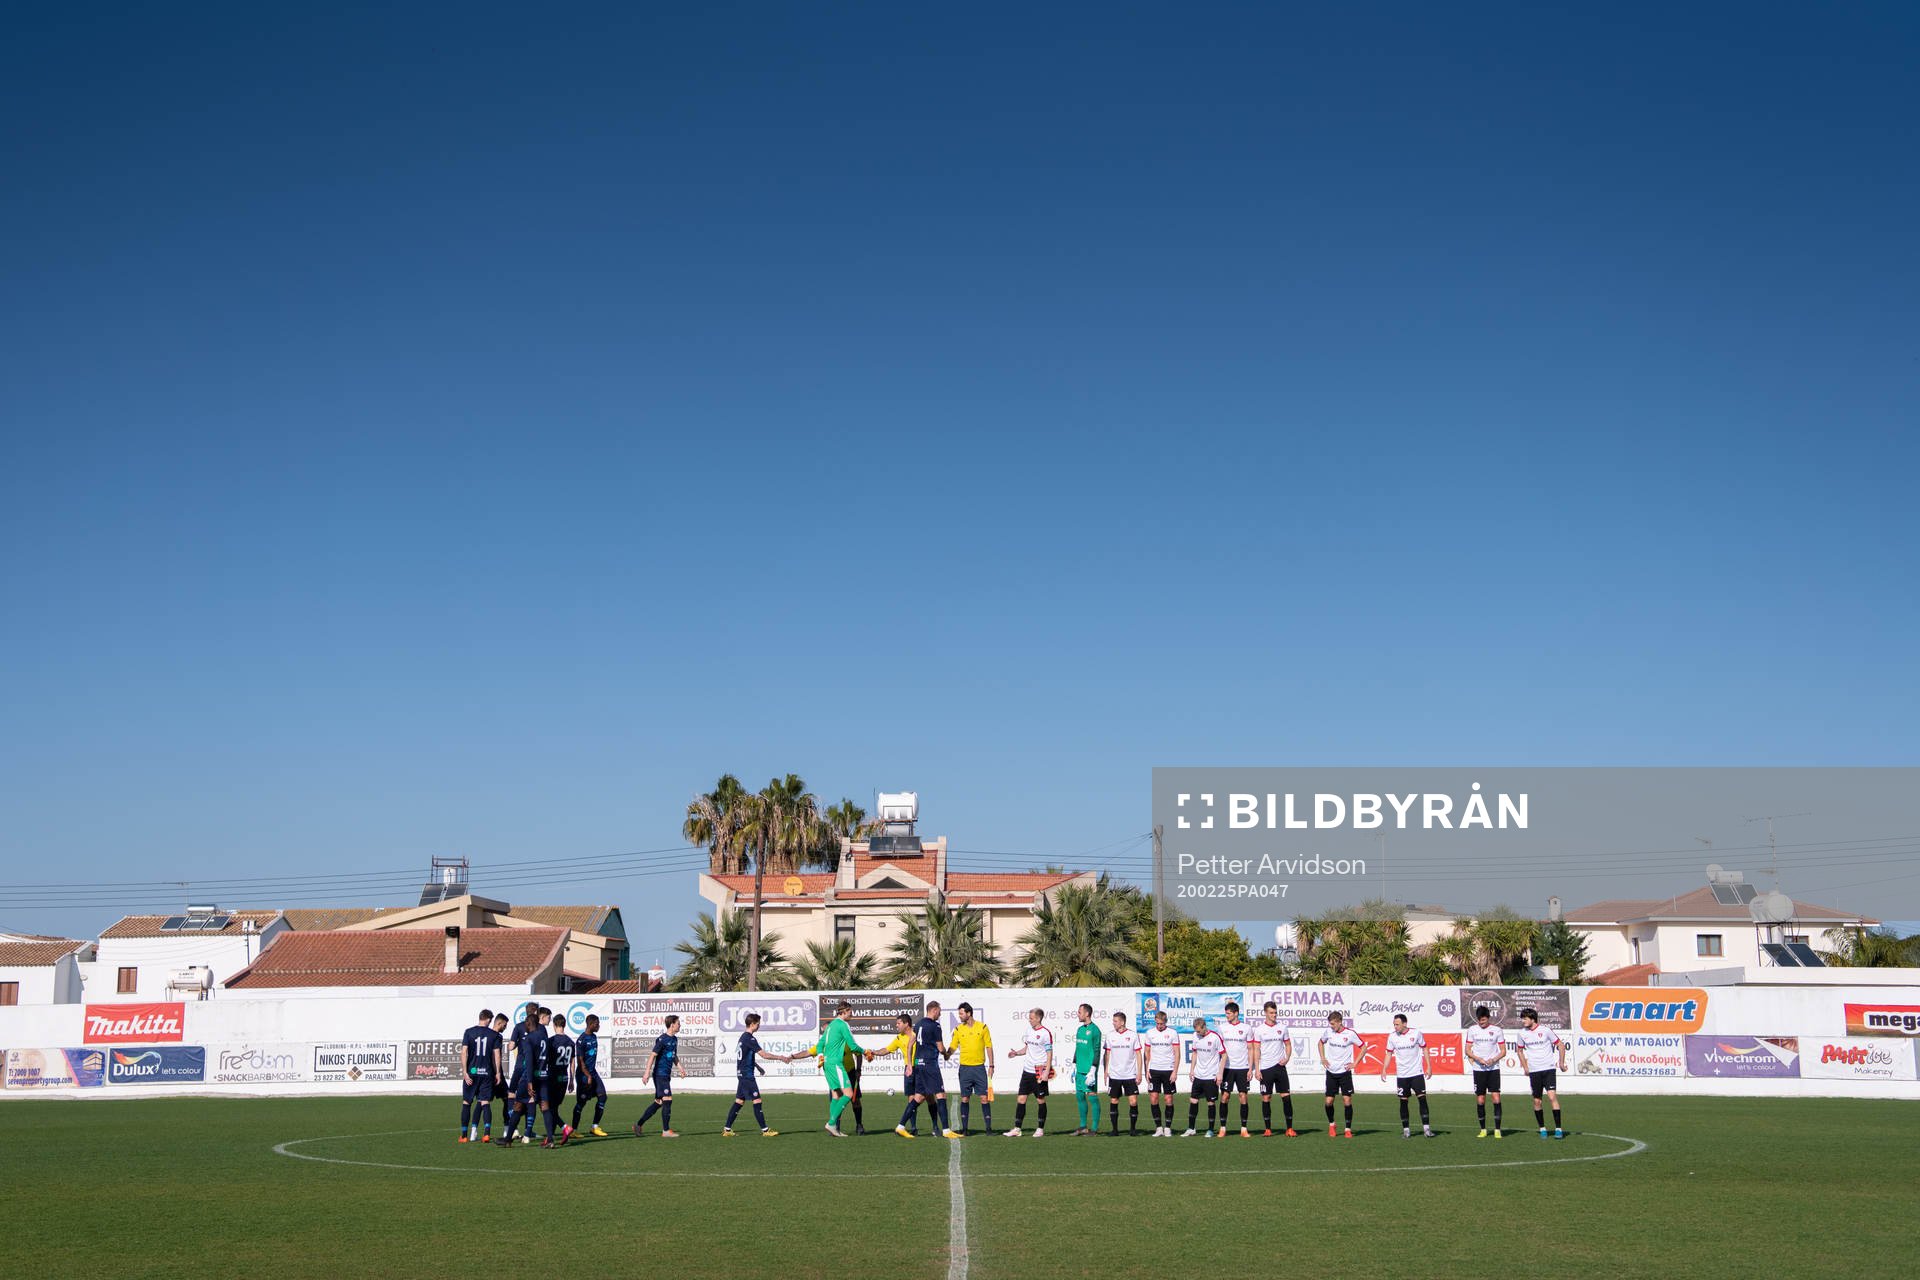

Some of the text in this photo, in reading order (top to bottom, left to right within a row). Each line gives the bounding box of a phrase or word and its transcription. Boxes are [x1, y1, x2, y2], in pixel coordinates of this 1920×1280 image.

[1271, 991, 1344, 1005] GEMABA
[616, 1000, 646, 1012] VASOS
[1589, 1000, 1697, 1020] smart
[613, 1017, 637, 1026] KEYS
[643, 1016, 666, 1026] STAM
[686, 1015, 714, 1025] SIGNS
[1869, 1013, 1920, 1030] meg
[917, 1026, 923, 1045] 4
[1625, 1037, 1680, 1046] ΜΑΤΘΑΙΟΥ
[409, 1043, 454, 1054] COFFEE
[475, 1037, 487, 1056] 11
[539, 1040, 546, 1060] 2
[319, 1053, 392, 1065] NIKOS FLOURKAS
[556, 1046, 572, 1066] 29
[1704, 1048, 1776, 1063] Vivechrom
[113, 1063, 154, 1076] Dulux
[178, 1067, 202, 1075] colour
